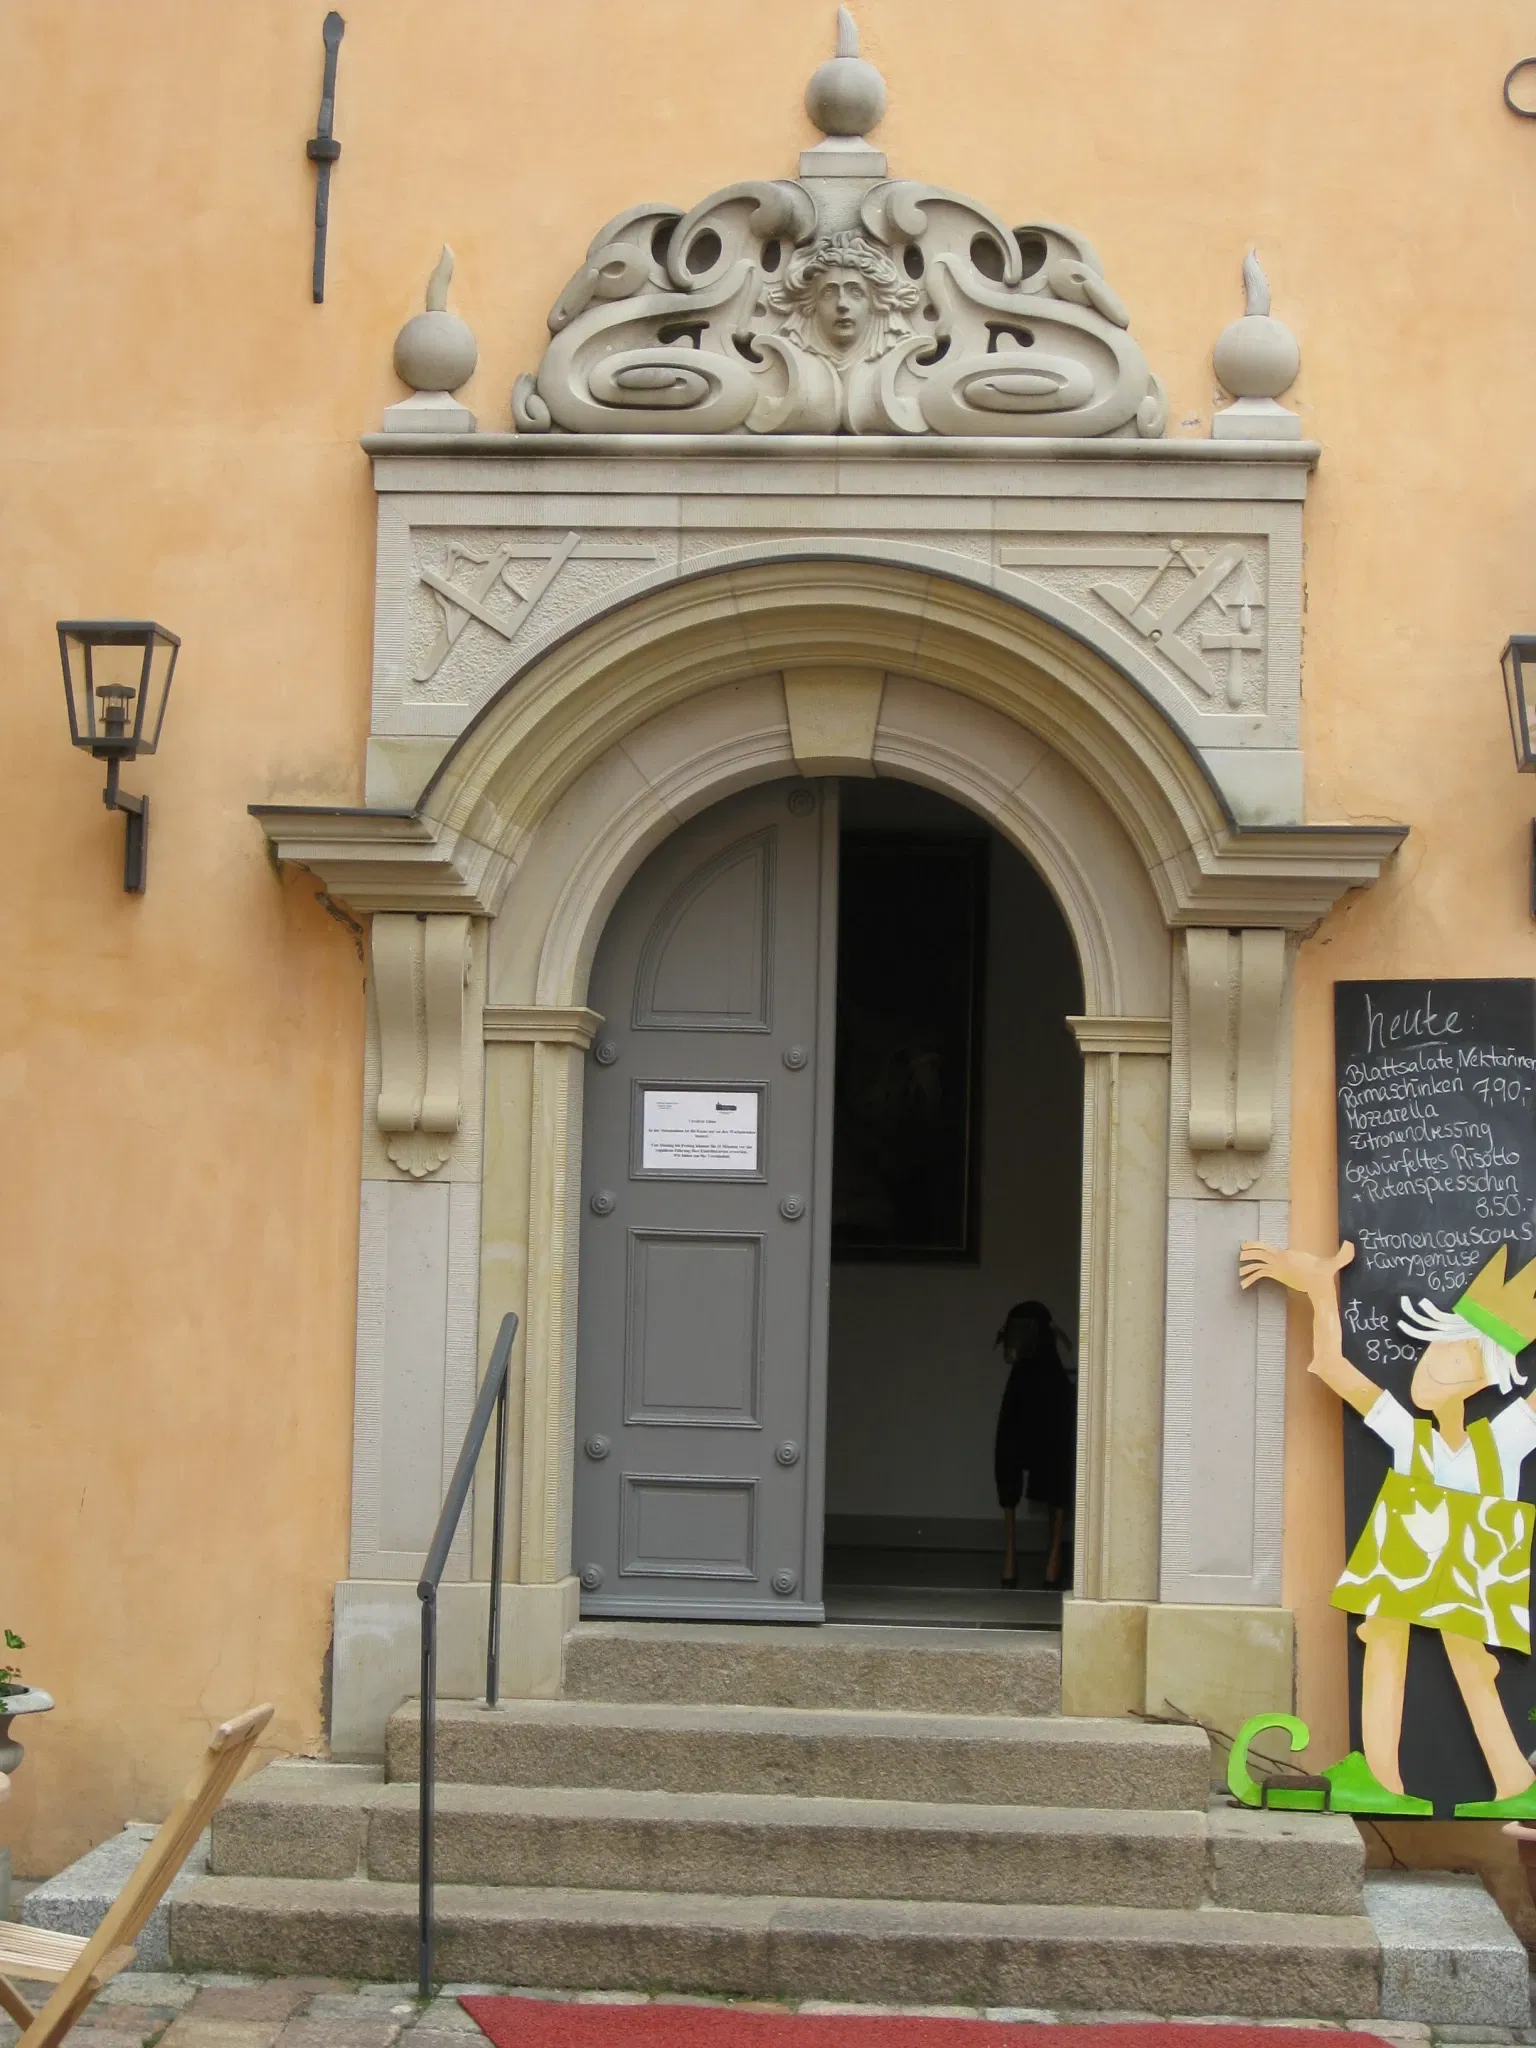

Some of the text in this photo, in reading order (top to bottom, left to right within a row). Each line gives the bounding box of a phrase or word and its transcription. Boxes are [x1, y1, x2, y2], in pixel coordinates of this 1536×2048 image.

[1365, 990, 1475, 1053] heute:
[1338, 1074, 1464, 1109] Parmaschinken
[1345, 1100, 1440, 1129] Mozzarella
[1349, 1119, 1494, 1152] Zitronendressing
[1345, 1143, 1520, 1183] Gewürfeltes Risotto
[1345, 1306, 1390, 1333] Pute
